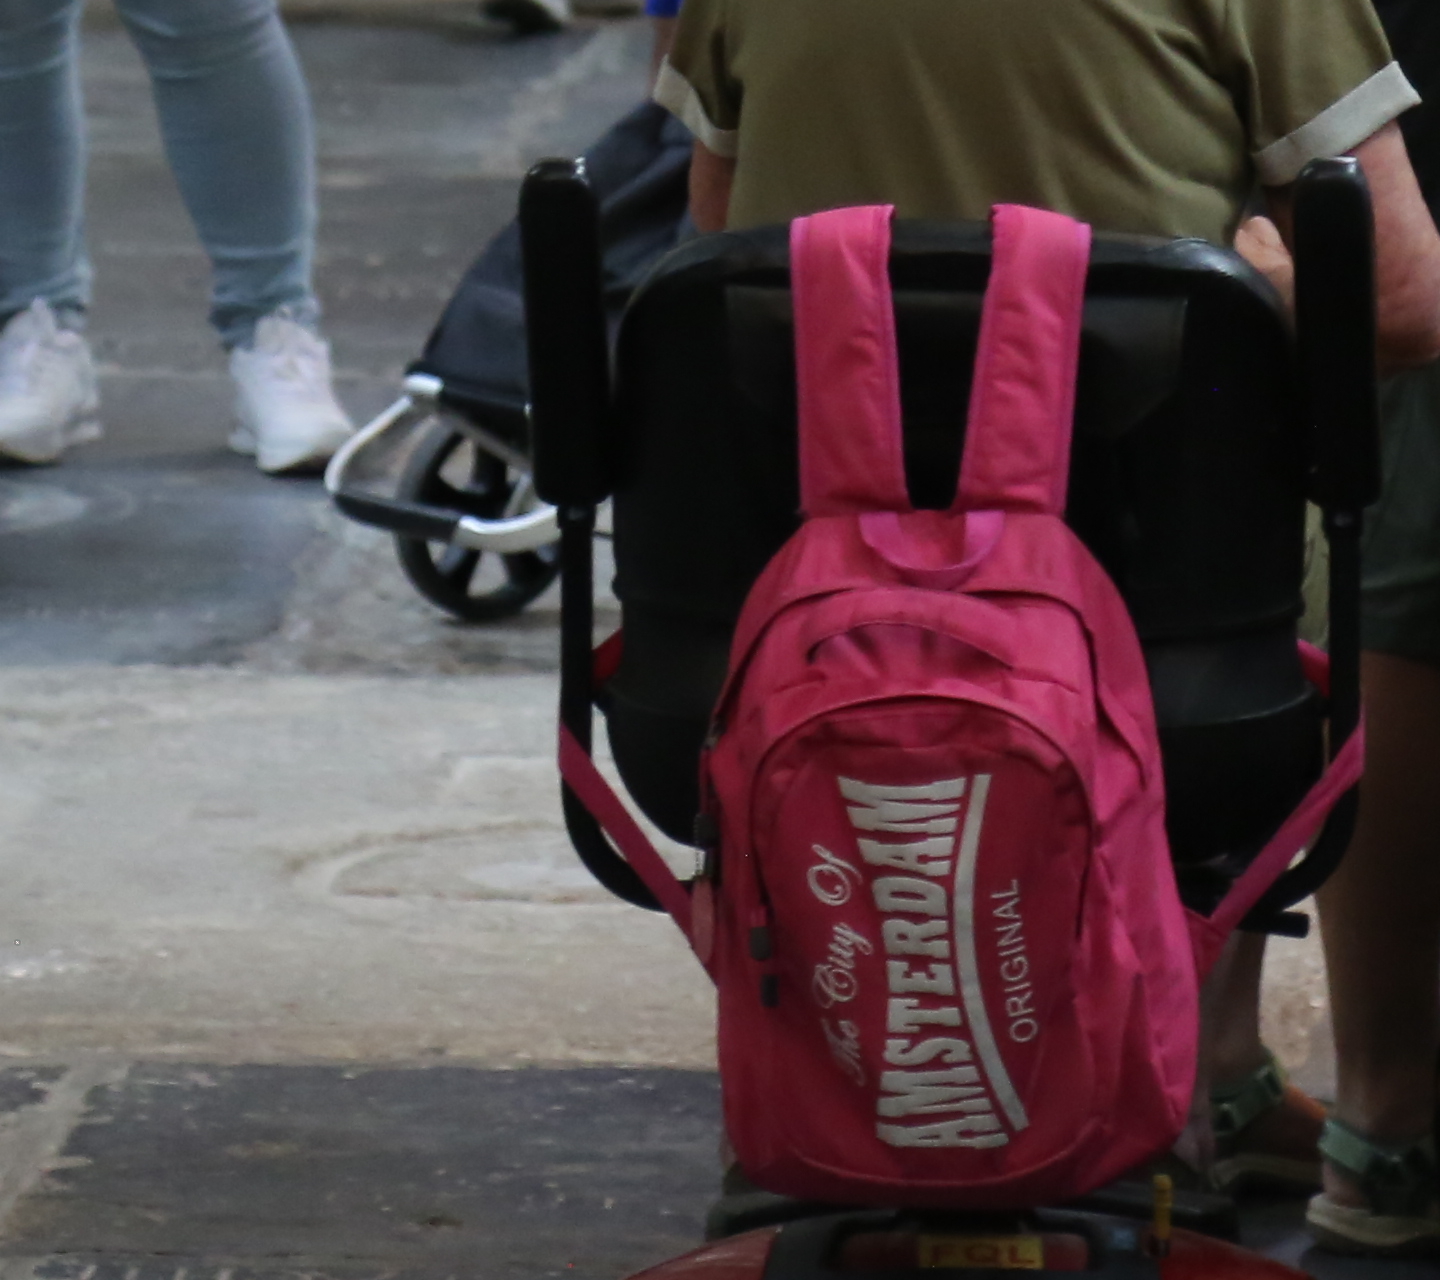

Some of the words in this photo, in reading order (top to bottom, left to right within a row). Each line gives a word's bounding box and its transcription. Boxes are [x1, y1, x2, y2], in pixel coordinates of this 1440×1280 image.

[806, 843, 863, 907] Of
[812, 921, 874, 1009] City
[838, 775, 1009, 1149] AMSTERDAM
[990, 879, 1039, 1042] ORIGINAL
